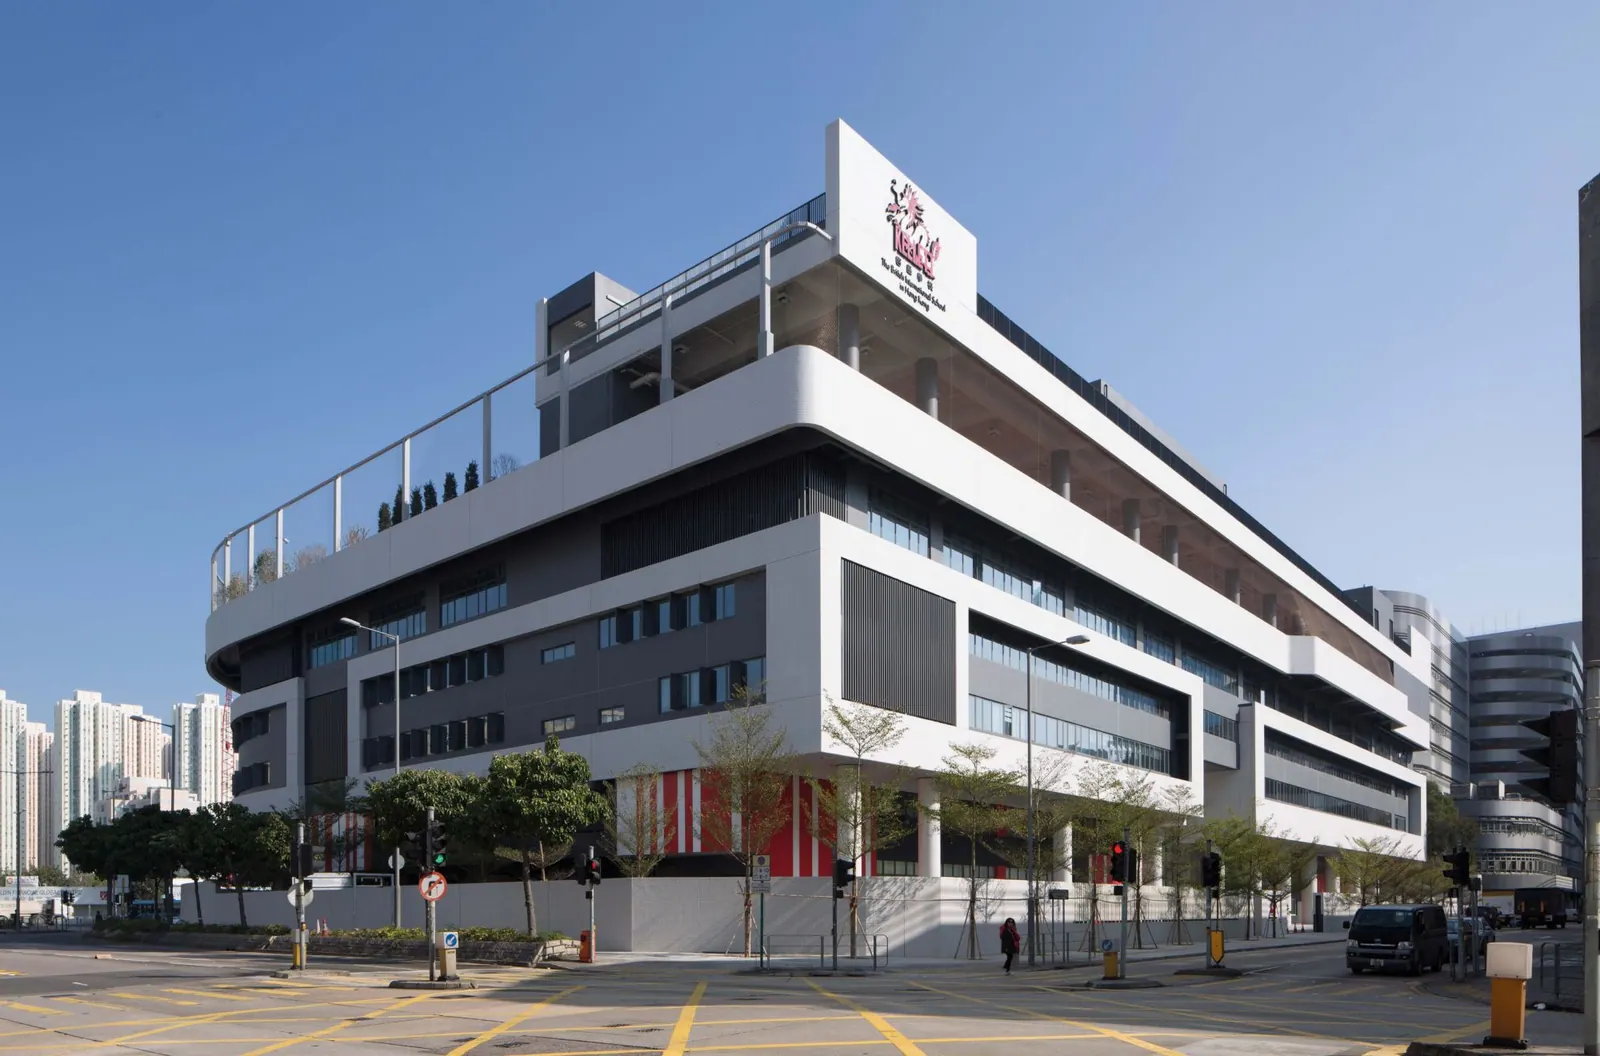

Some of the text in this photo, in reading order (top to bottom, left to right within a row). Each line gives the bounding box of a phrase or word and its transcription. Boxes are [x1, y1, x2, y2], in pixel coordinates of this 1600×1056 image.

[881, 257, 890, 270] The
[890, 265, 904, 281] British
[905, 275, 931, 301] International
[931, 296, 946, 312] School
[899, 283, 929, 312] in Hong Kong
